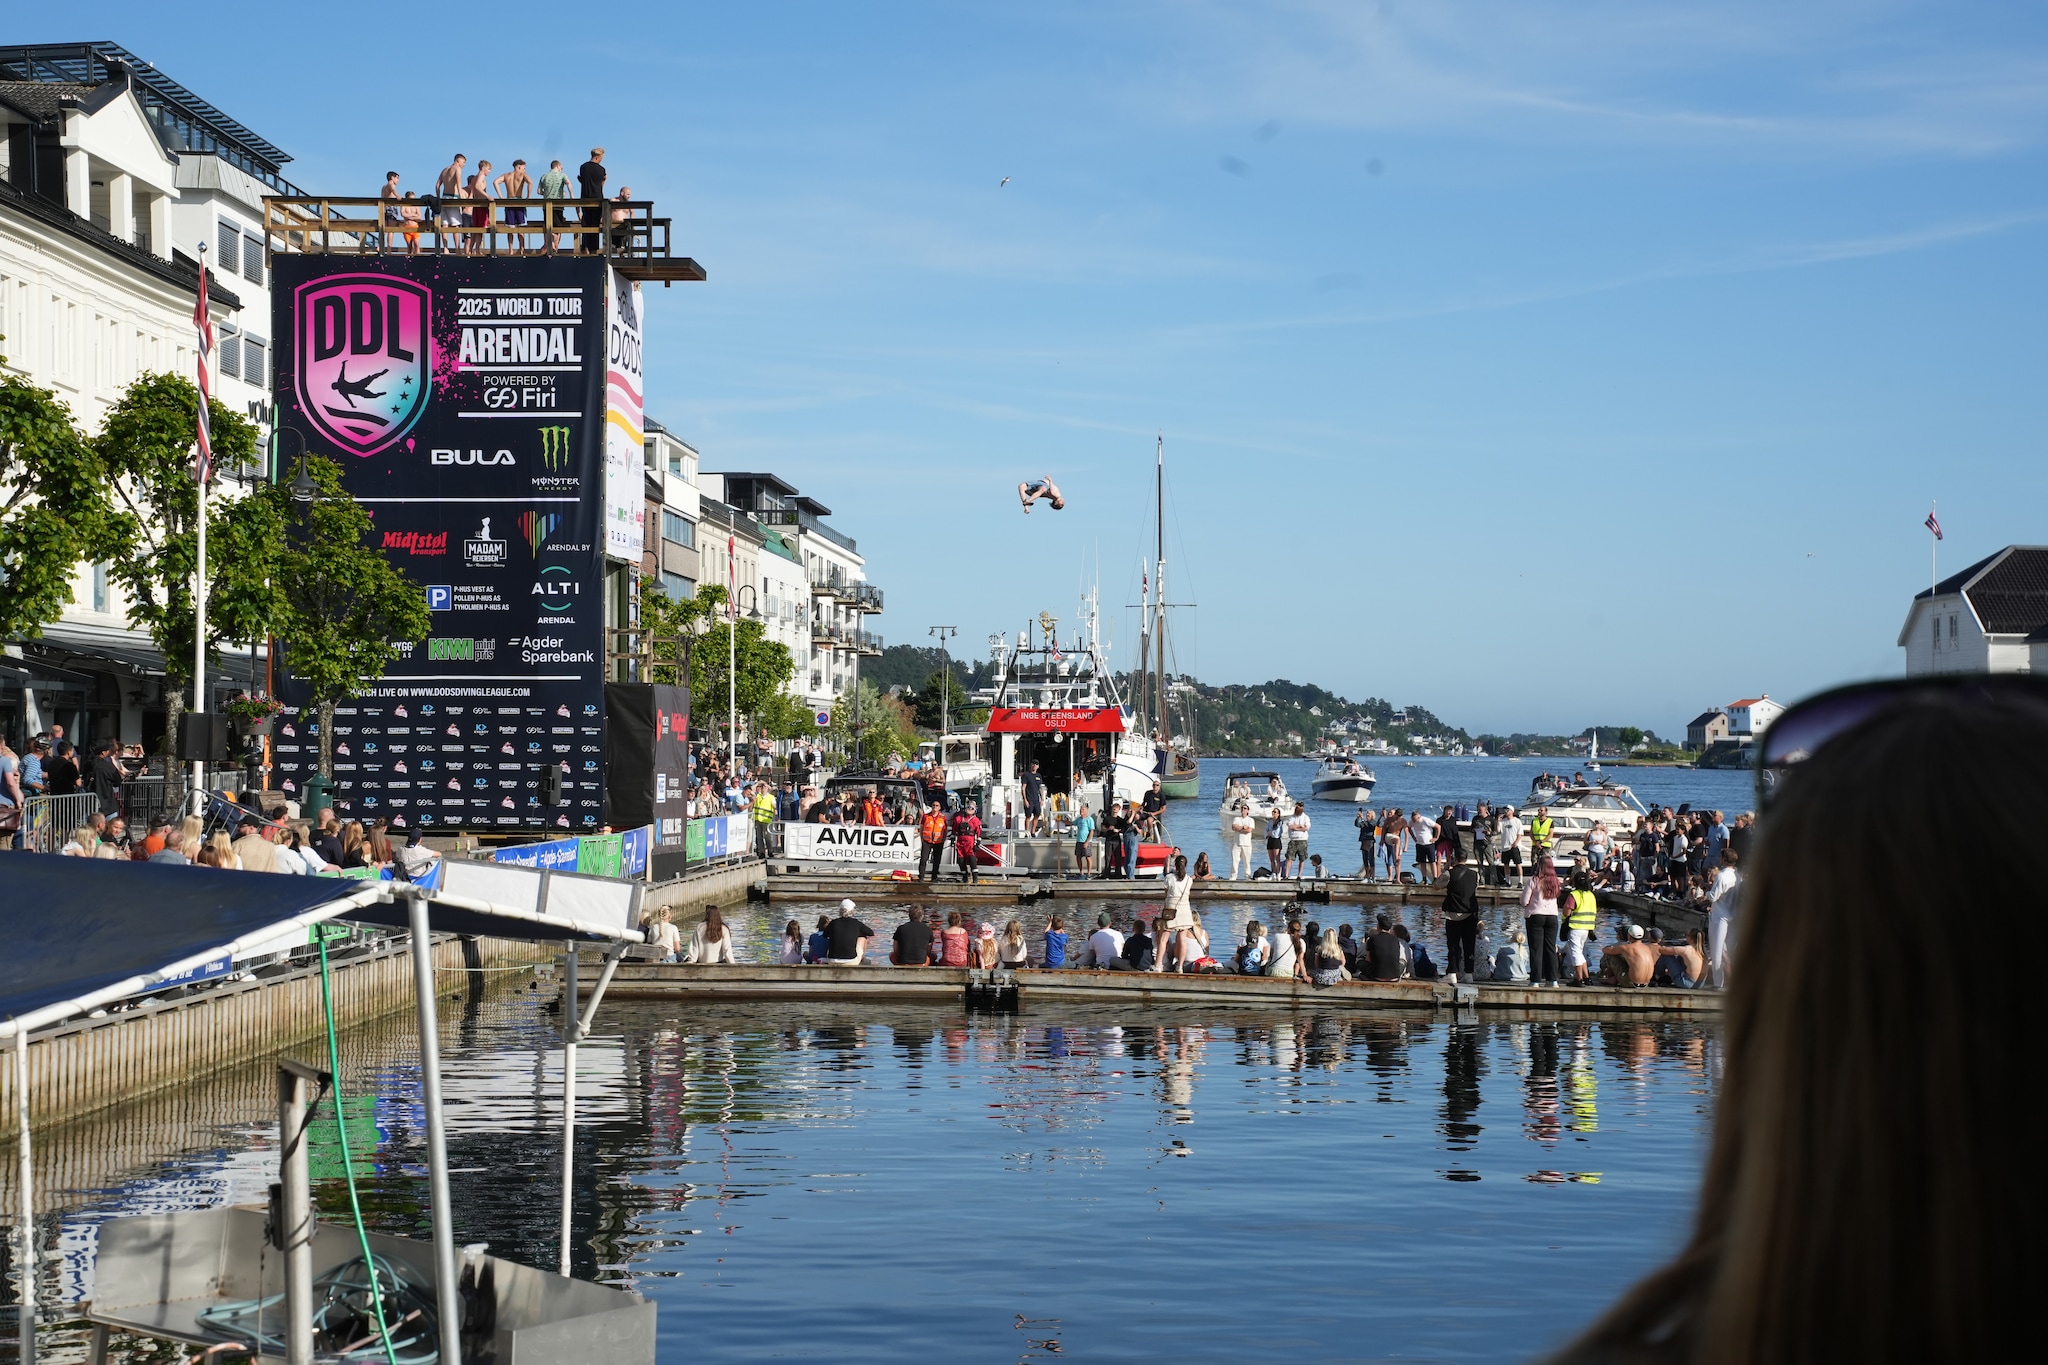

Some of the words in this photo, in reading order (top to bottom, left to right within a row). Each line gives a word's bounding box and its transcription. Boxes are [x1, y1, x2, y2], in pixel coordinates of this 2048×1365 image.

[458, 298, 492, 316] 2025
[496, 298, 542, 316] WORLD
[547, 298, 582, 316] TOUR
[314, 292, 414, 363] DDL
[458, 327, 582, 363] ARENDAL
[484, 376, 539, 386] POWERED
[542, 376, 556, 386] BY
[522, 387, 556, 408] Firi
[430, 450, 516, 465] BULA
[532, 476, 580, 486] MONSTER
[468, 543, 502, 556] MADAM
[532, 582, 580, 594] ALTI
[432, 588, 447, 607] P
[428, 638, 474, 660] KIWI
[475, 638, 496, 650] mini
[522, 636, 564, 650] Agder
[475, 650, 494, 662] pris
[521, 650, 594, 665] Sparebank
[378, 688, 396, 697] LIVE
[397, 688, 409, 697] ON
[410, 688, 530, 697] WWW.DODSDIVINGLEAGUE.COM
[816, 828, 909, 847] AMIGA
[816, 848, 910, 860] GARDEROBEN
